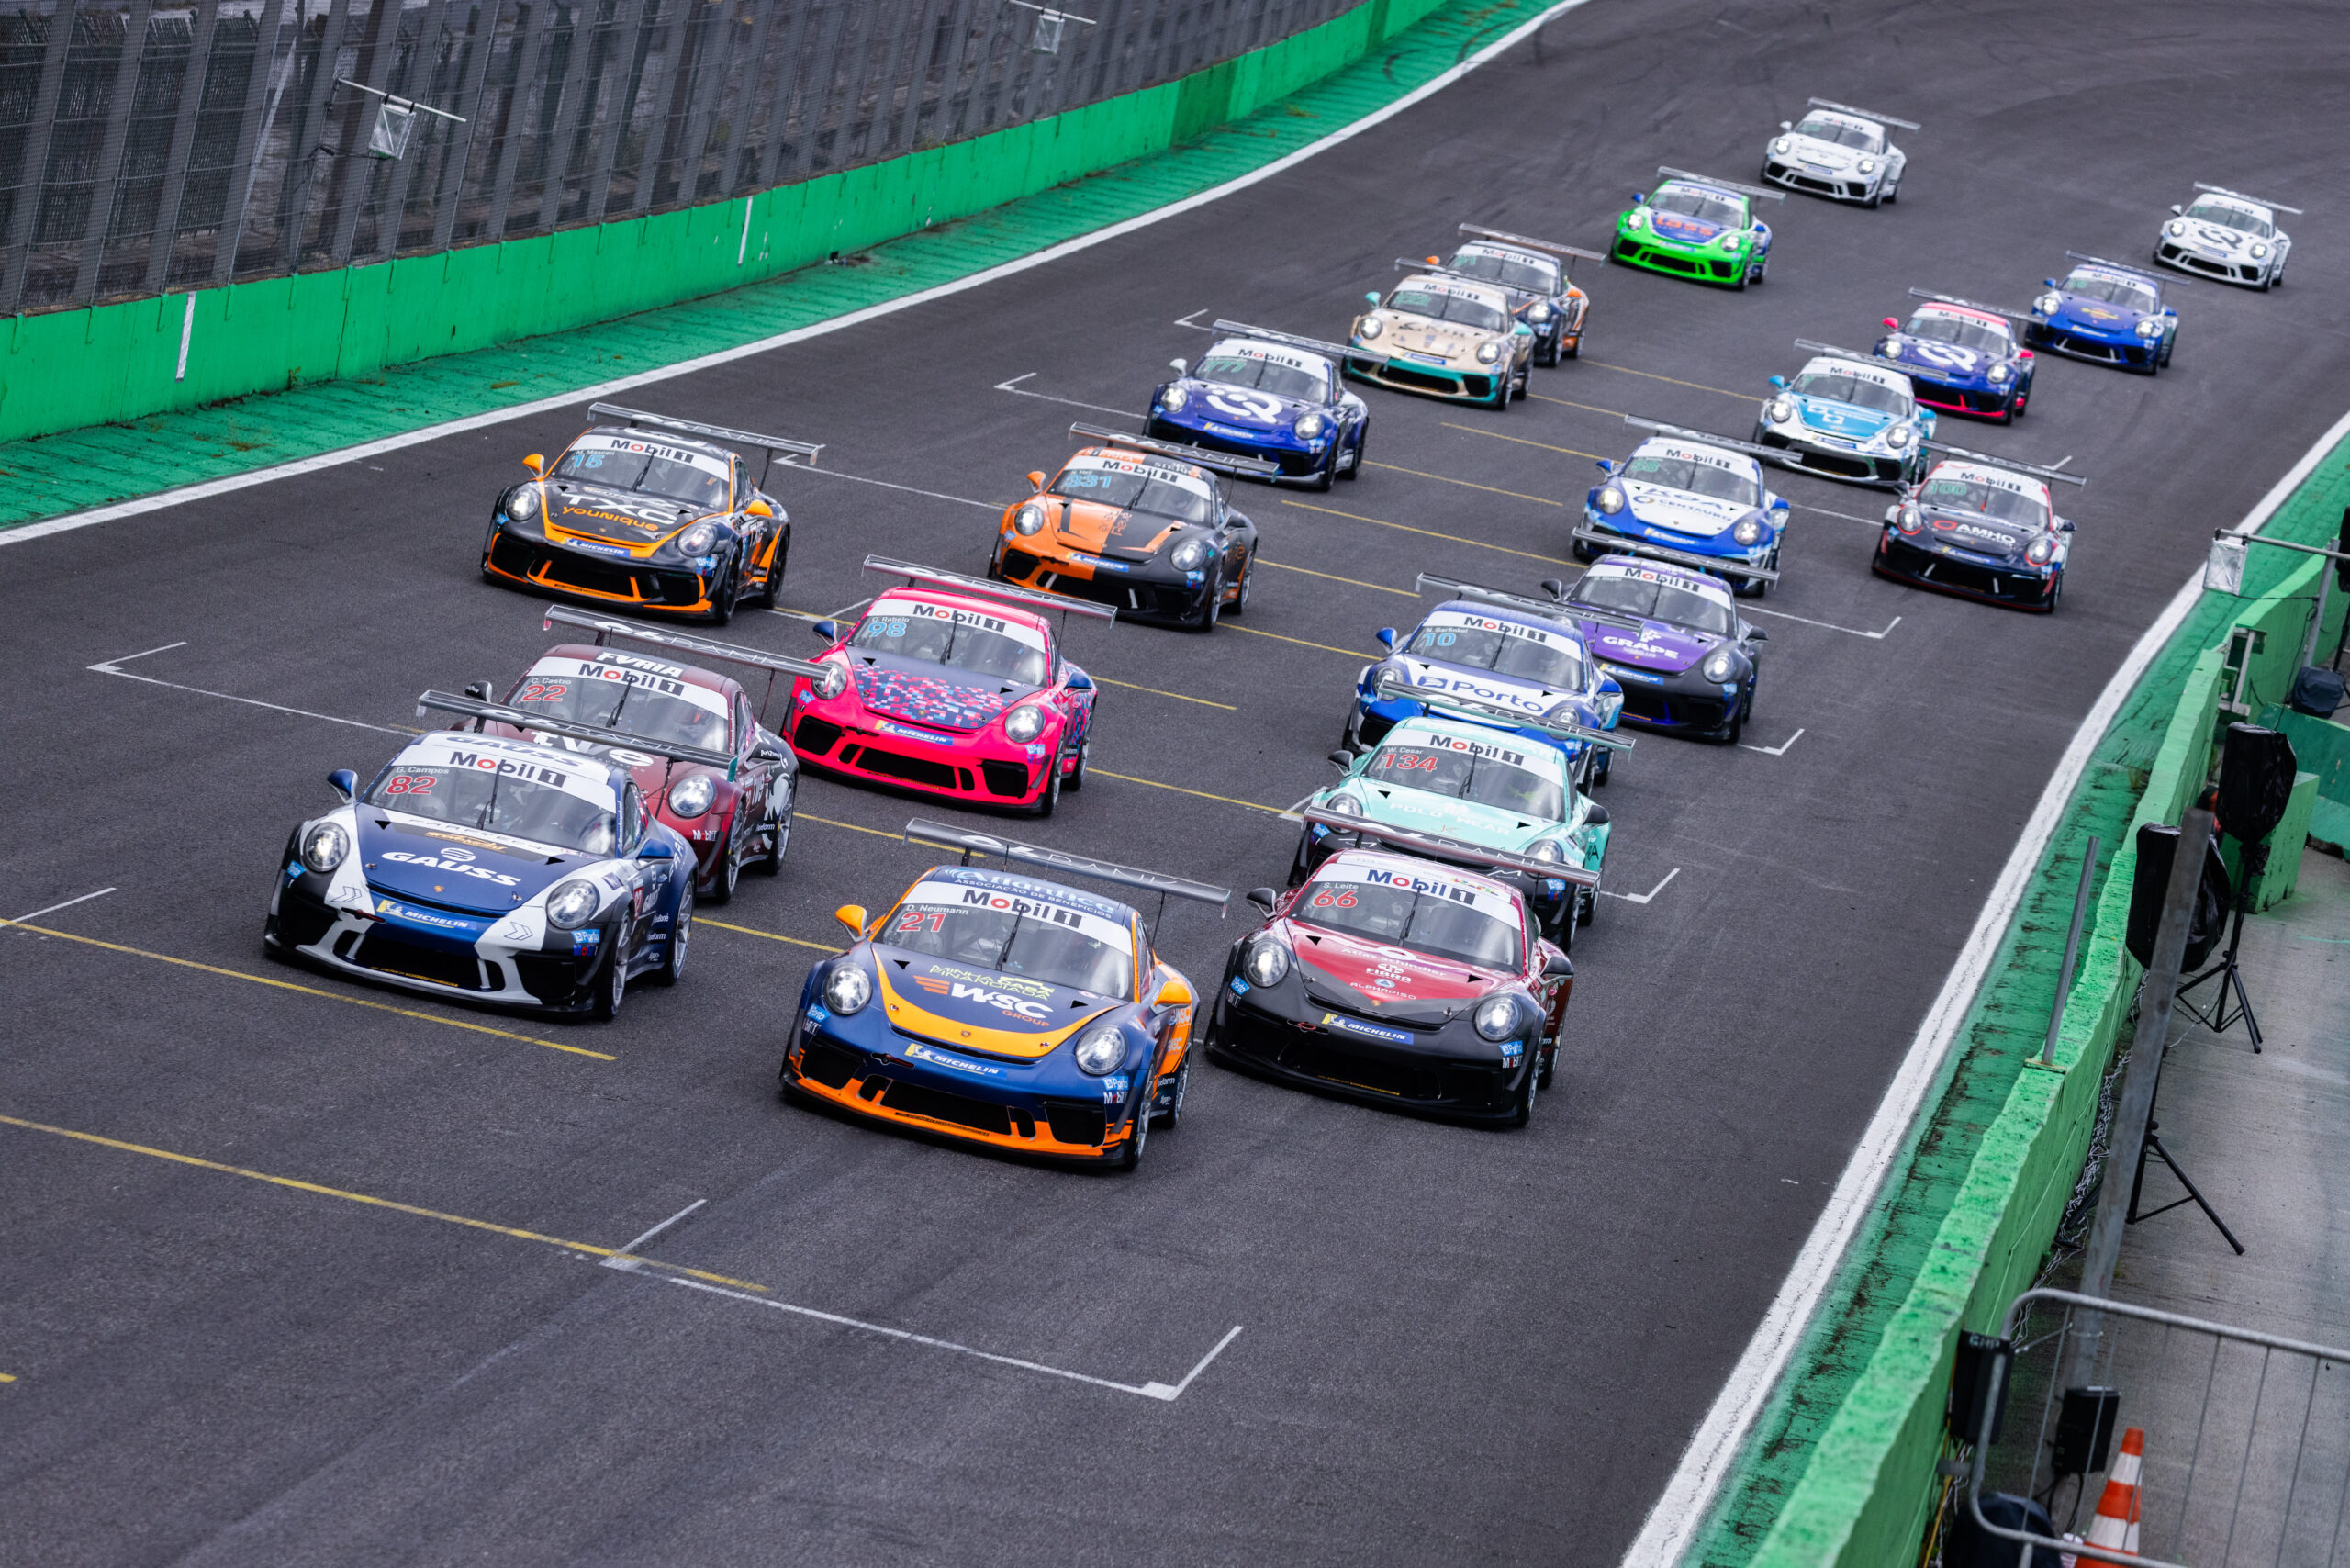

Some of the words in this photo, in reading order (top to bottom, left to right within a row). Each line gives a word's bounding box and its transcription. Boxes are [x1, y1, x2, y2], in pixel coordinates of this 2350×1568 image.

[1424, 283, 1464, 297] Mobil
[1238, 348, 1284, 364] Mobil
[1830, 367, 1871, 380] Mobil
[610, 439, 671, 457] Mobil
[1666, 449, 1713, 464] Mobil
[571, 454, 605, 468] 15
[1102, 460, 1158, 477] Mobil
[1065, 475, 1112, 488] 331
[1930, 482, 1968, 496] 100
[1961, 472, 2005, 487] Mobil
[561, 493, 677, 525] TXC
[580, 543, 625, 554] MICHELIN
[1625, 568, 1679, 587] Mobil
[912, 604, 980, 626] Mobil
[868, 622, 907, 637] 98
[1464, 616, 1524, 636] Mobil
[1423, 633, 1457, 647] 10
[1602, 635, 1679, 659] GRAPE
[579, 664, 655, 688] Mobil
[521, 685, 567, 701] 22
[1451, 681, 1544, 713] Porto
[897, 728, 947, 743] MICHELIN
[446, 735, 582, 767] GAUSS
[1430, 734, 1498, 758] Mobil
[408, 767, 450, 776] Campos
[449, 751, 536, 778] Mobil
[1382, 753, 1438, 773] 134
[386, 776, 436, 795] 82
[1390, 802, 1443, 818] POLO
[1456, 817, 1511, 835] WEAR
[382, 852, 521, 886] GAUSS
[1366, 869, 1446, 897] Mobil
[955, 879, 1026, 895] ASSOCIAÇÃO
[1030, 890, 1046, 899] DE
[1047, 894, 1113, 919] BENEFÍCIOS
[962, 890, 1050, 919] Mobil
[1313, 890, 1360, 908] 66
[919, 904, 969, 915] Neumann
[405, 911, 470, 928] MICHELIN
[897, 912, 946, 933] 21
[1341, 947, 1377, 959] Atlas
[1380, 956, 1448, 977] Schindler
[930, 969, 1048, 1001] FINANCIADA
[932, 965, 992, 981] MINHA
[997, 979, 1052, 997] CASA
[1366, 968, 1412, 984] FIBRA
[951, 983, 1054, 1019] WSC
[1002, 1009, 1050, 1027] GROUP
[1348, 1023, 1406, 1040] MICHELIN
[934, 1055, 1000, 1075] MICHELIN
